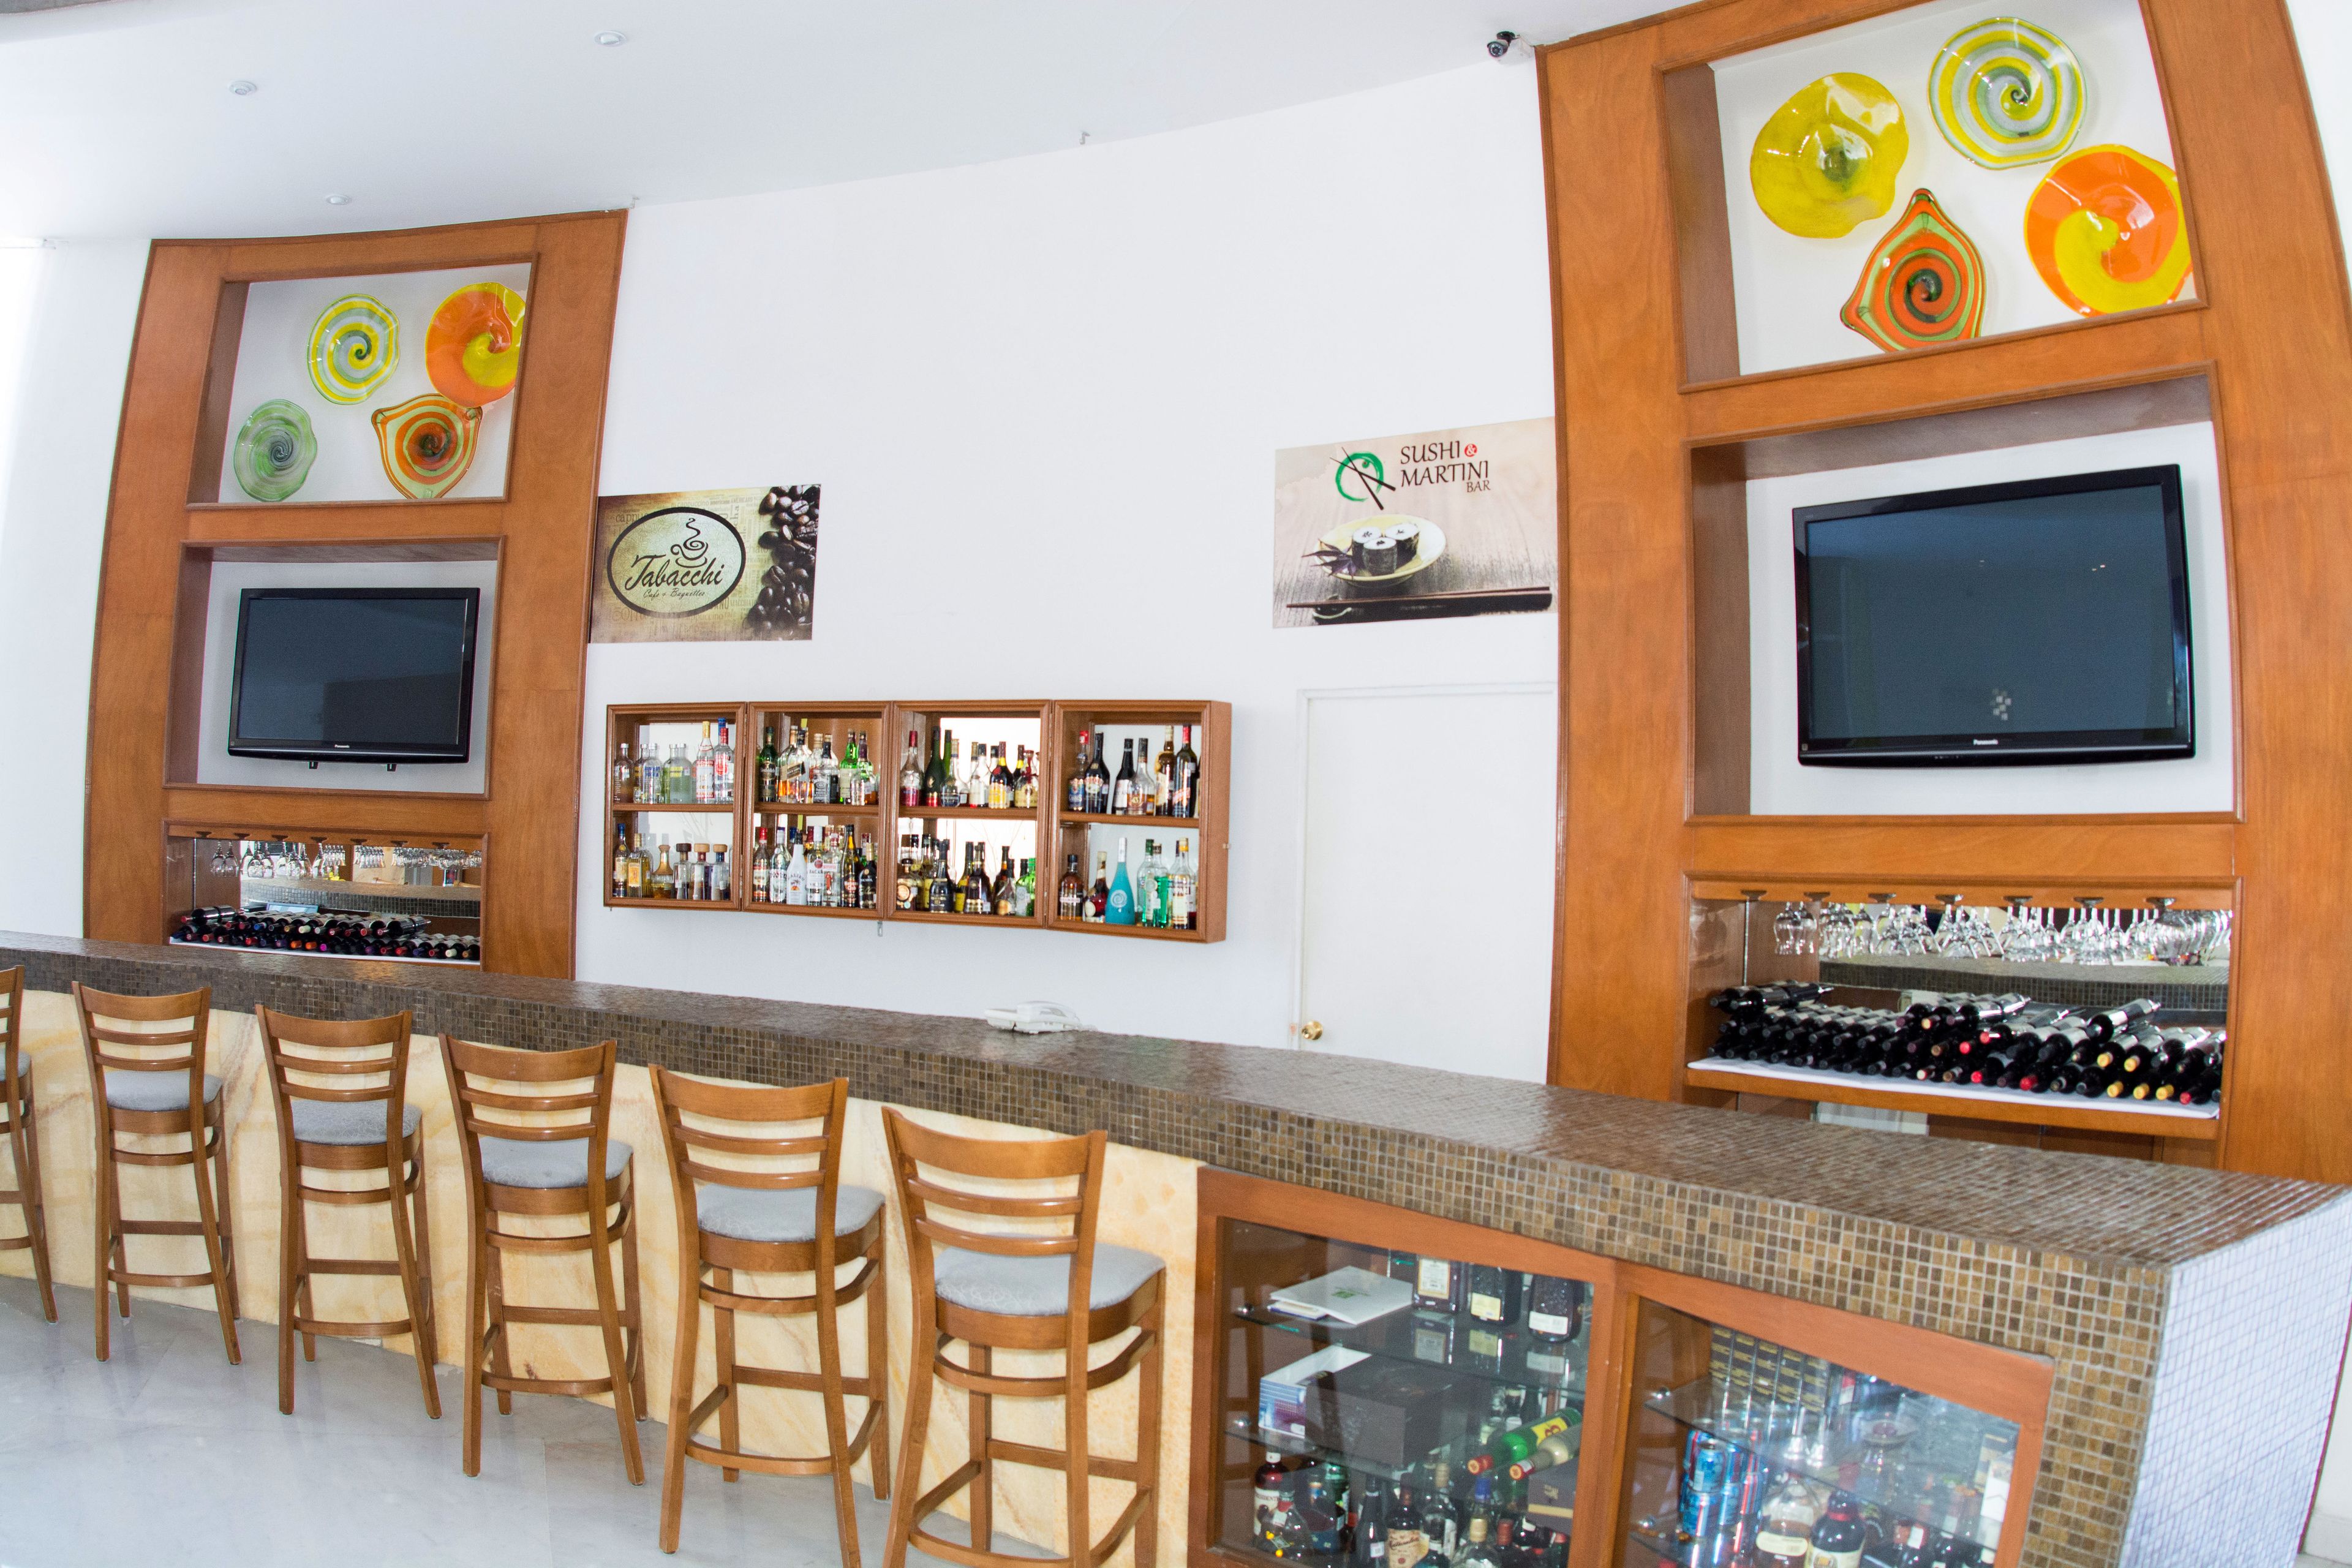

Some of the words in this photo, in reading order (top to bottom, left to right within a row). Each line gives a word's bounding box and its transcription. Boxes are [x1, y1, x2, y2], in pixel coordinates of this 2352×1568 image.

[1400, 440, 1460, 465] SUSHI
[1464, 443, 1478, 458] &
[1400, 460, 1488, 488] MARTINI
[1466, 480, 1491, 492] BAR
[624, 554, 725, 590] Tabacchi
[670, 587, 705, 600] Baguettes
